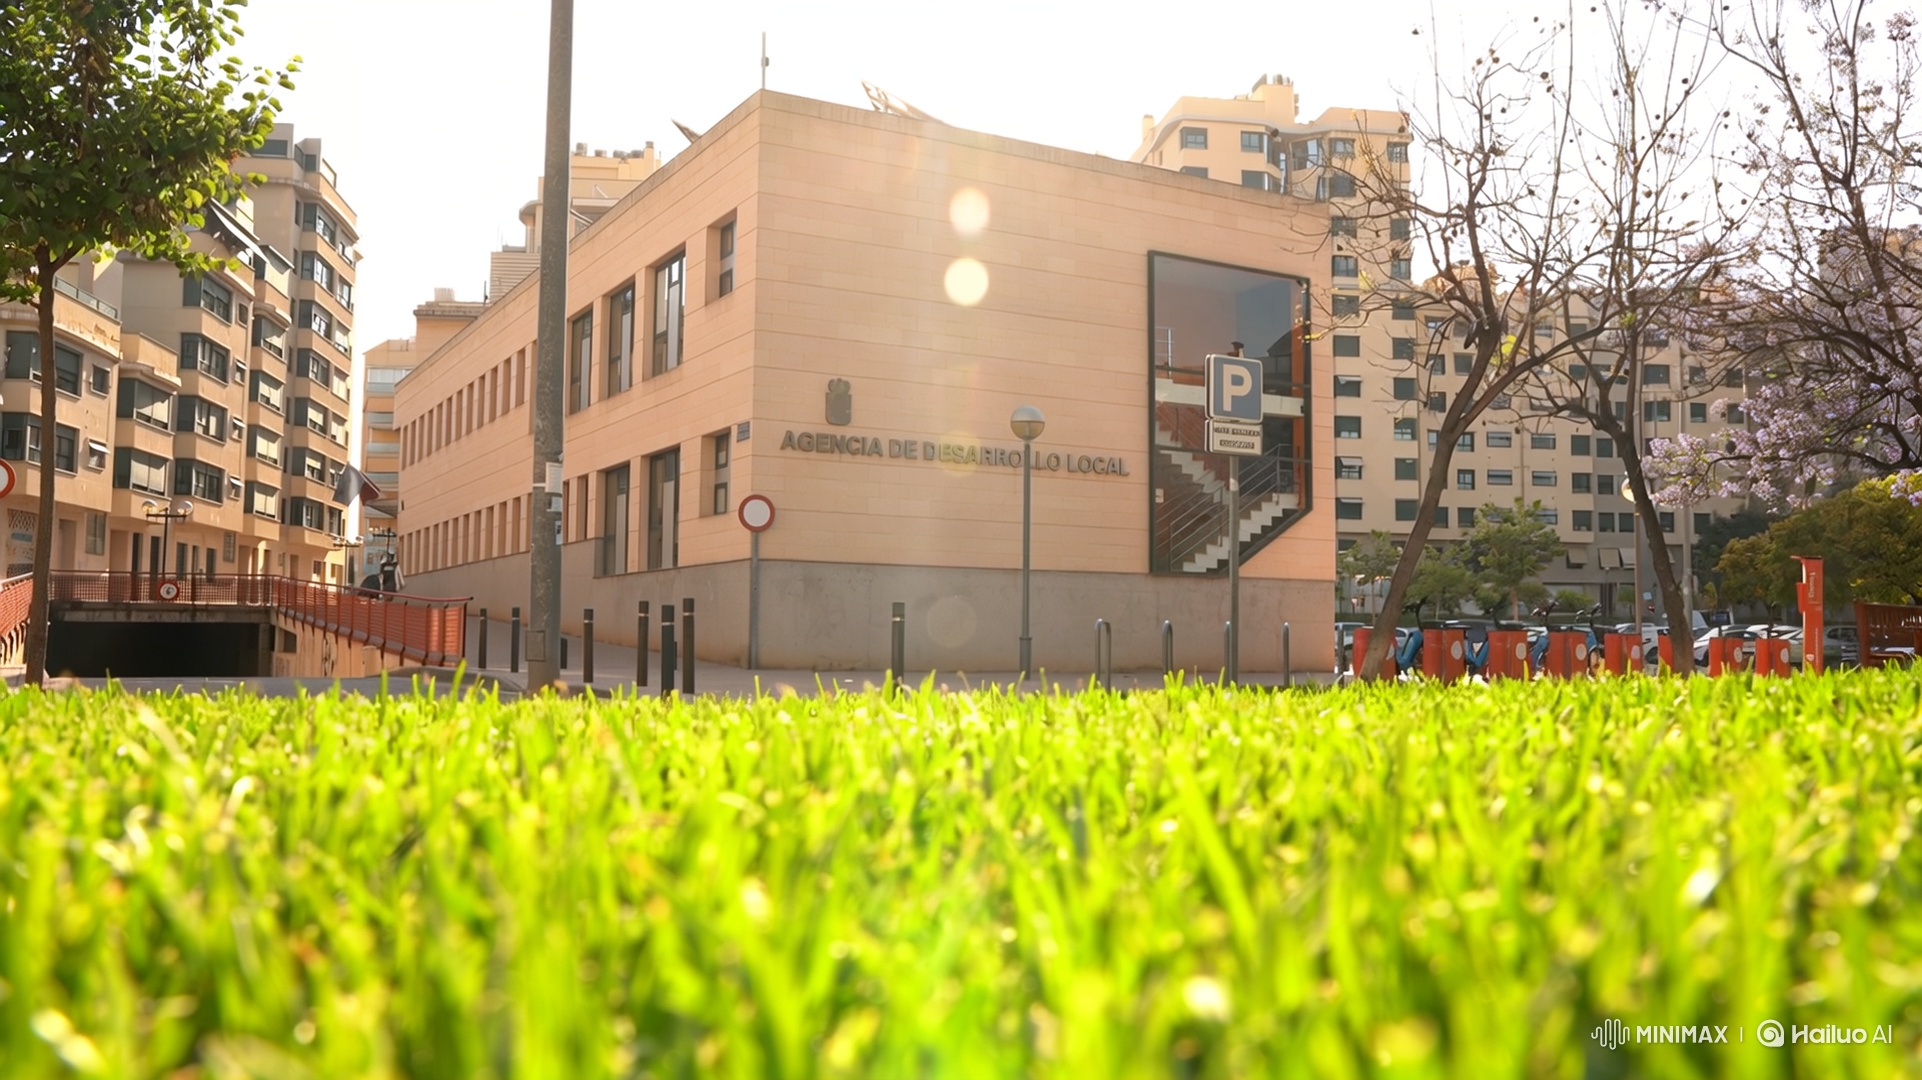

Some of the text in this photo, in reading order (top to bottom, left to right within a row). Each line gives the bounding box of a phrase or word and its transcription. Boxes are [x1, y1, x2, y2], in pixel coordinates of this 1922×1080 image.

[1222, 363, 1253, 412] P
[780, 430, 1130, 477] AGENCIA DE DESARROLO LOCAL
